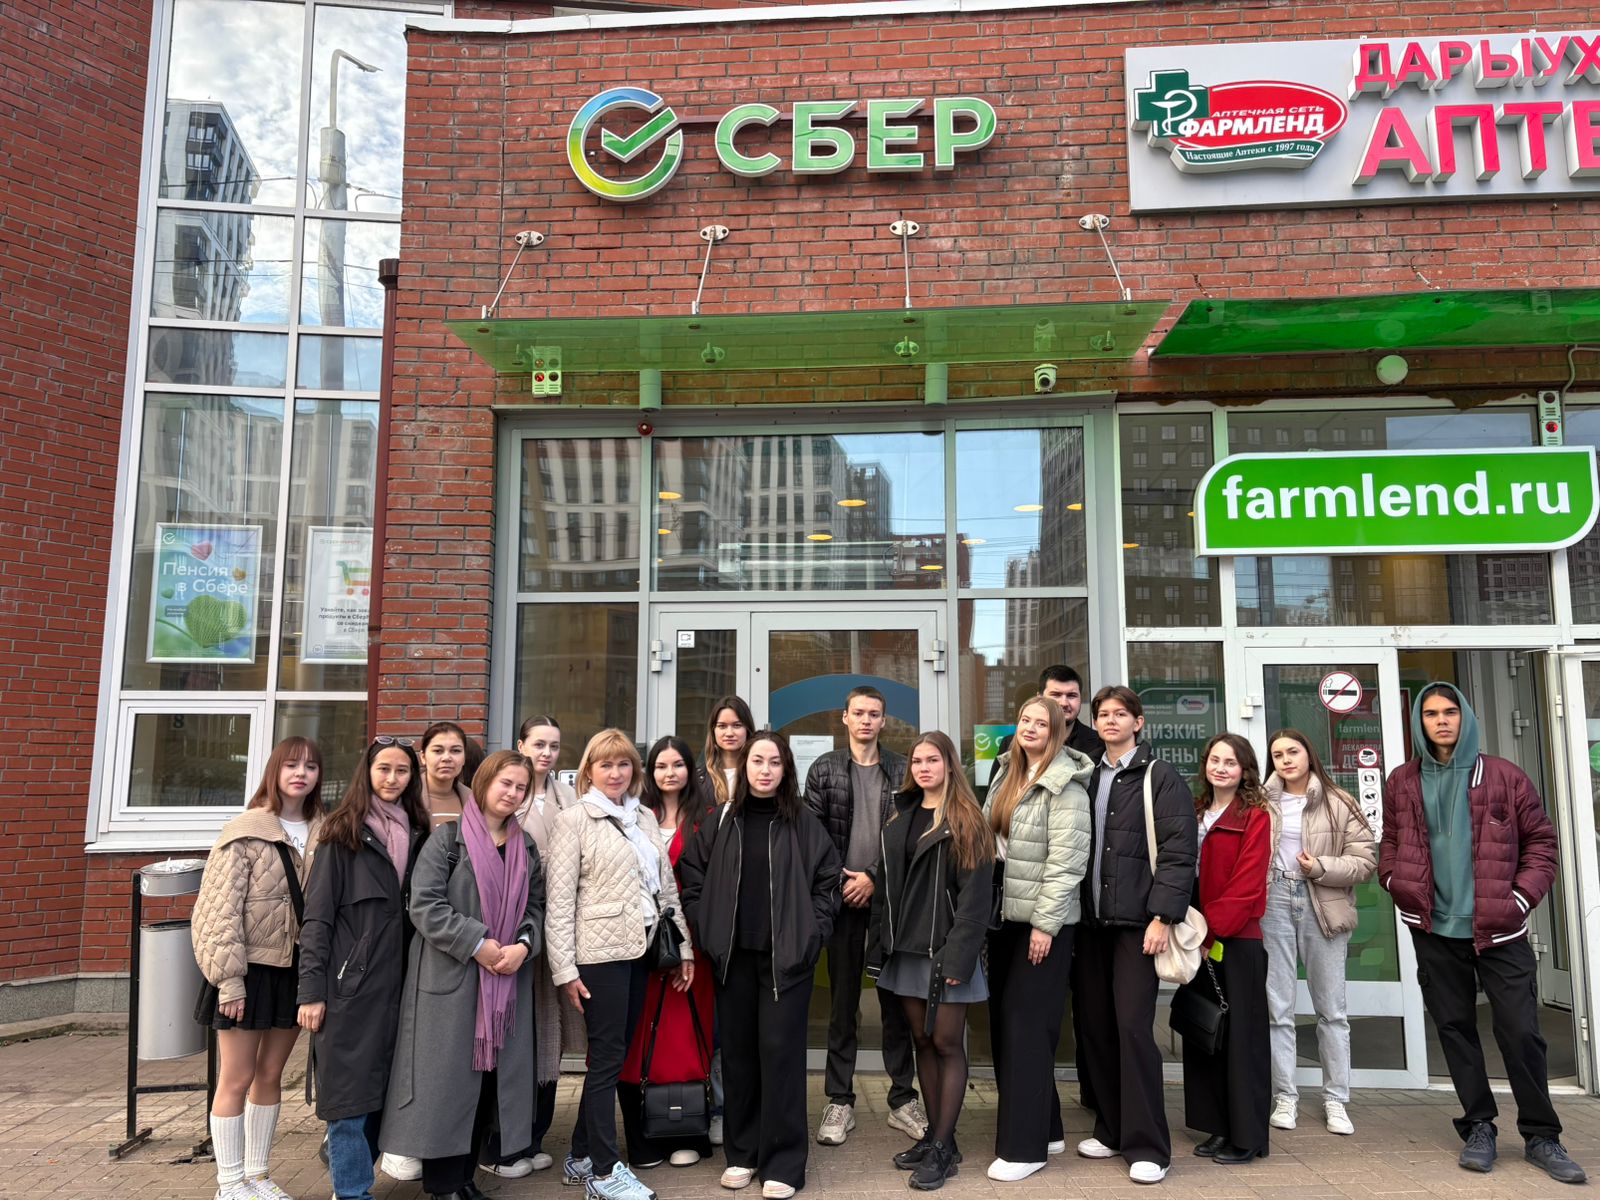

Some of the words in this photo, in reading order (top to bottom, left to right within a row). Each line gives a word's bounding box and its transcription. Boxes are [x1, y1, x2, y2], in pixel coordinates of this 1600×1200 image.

[1211, 107, 1285, 118] АПТЕЧНАЯ
[1289, 105, 1325, 113] СЕТЬ
[1178, 113, 1325, 138] ФАРМЛЕНД
[715, 97, 997, 177] СБЕР
[1358, 101, 1600, 179] АПТЕ
[1185, 150, 1234, 161] Настоящие
[1235, 147, 1266, 157] Аптеки
[1275, 142, 1295, 152] 1997
[1296, 143, 1315, 153] года
[1222, 470, 1571, 520] farmlend.ru
[162, 561, 229, 577] Пенсия
[177, 582, 187, 592] в
[192, 579, 248, 597] Сбере
[1142, 722, 1206, 740] НИЗКИЕ
[1338, 723, 1380, 734] farmlen
